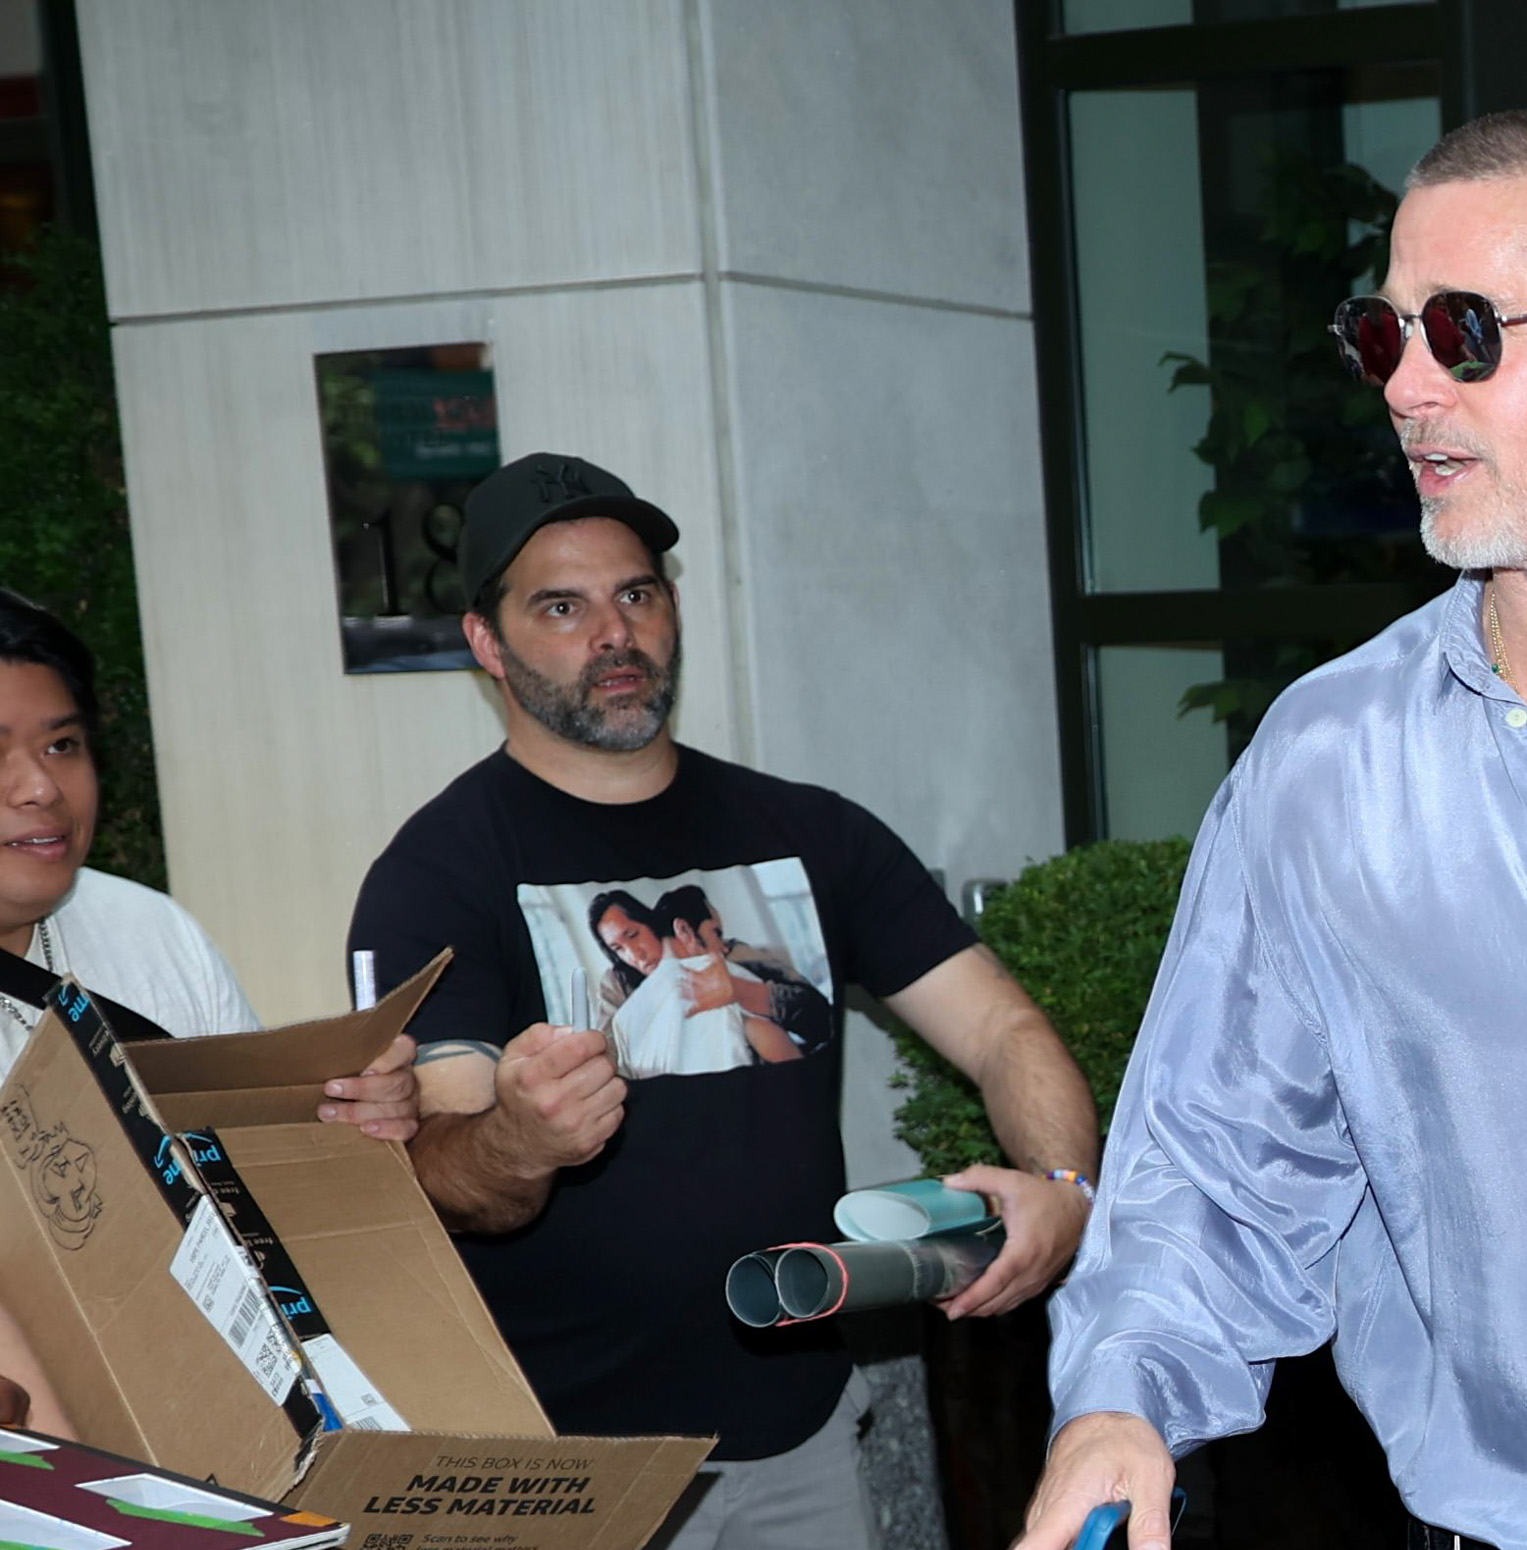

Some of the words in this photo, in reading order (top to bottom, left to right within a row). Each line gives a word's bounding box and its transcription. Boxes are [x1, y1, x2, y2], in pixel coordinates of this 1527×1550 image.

[193, 1144, 221, 1167] pri
[281, 1296, 312, 1320] pri
[436, 1455, 478, 1469] THIS
[482, 1457, 521, 1470] BOX
[524, 1458, 543, 1470] IS
[546, 1458, 594, 1470] NOW
[406, 1475, 503, 1494] MADE
[508, 1476, 591, 1494] WITH
[363, 1496, 443, 1515] LESS
[446, 1497, 597, 1516] MATERIAL
[423, 1533, 454, 1543] Scan
[456, 1534, 468, 1543] to
[470, 1535, 492, 1543] see
[493, 1534, 519, 1545] why
